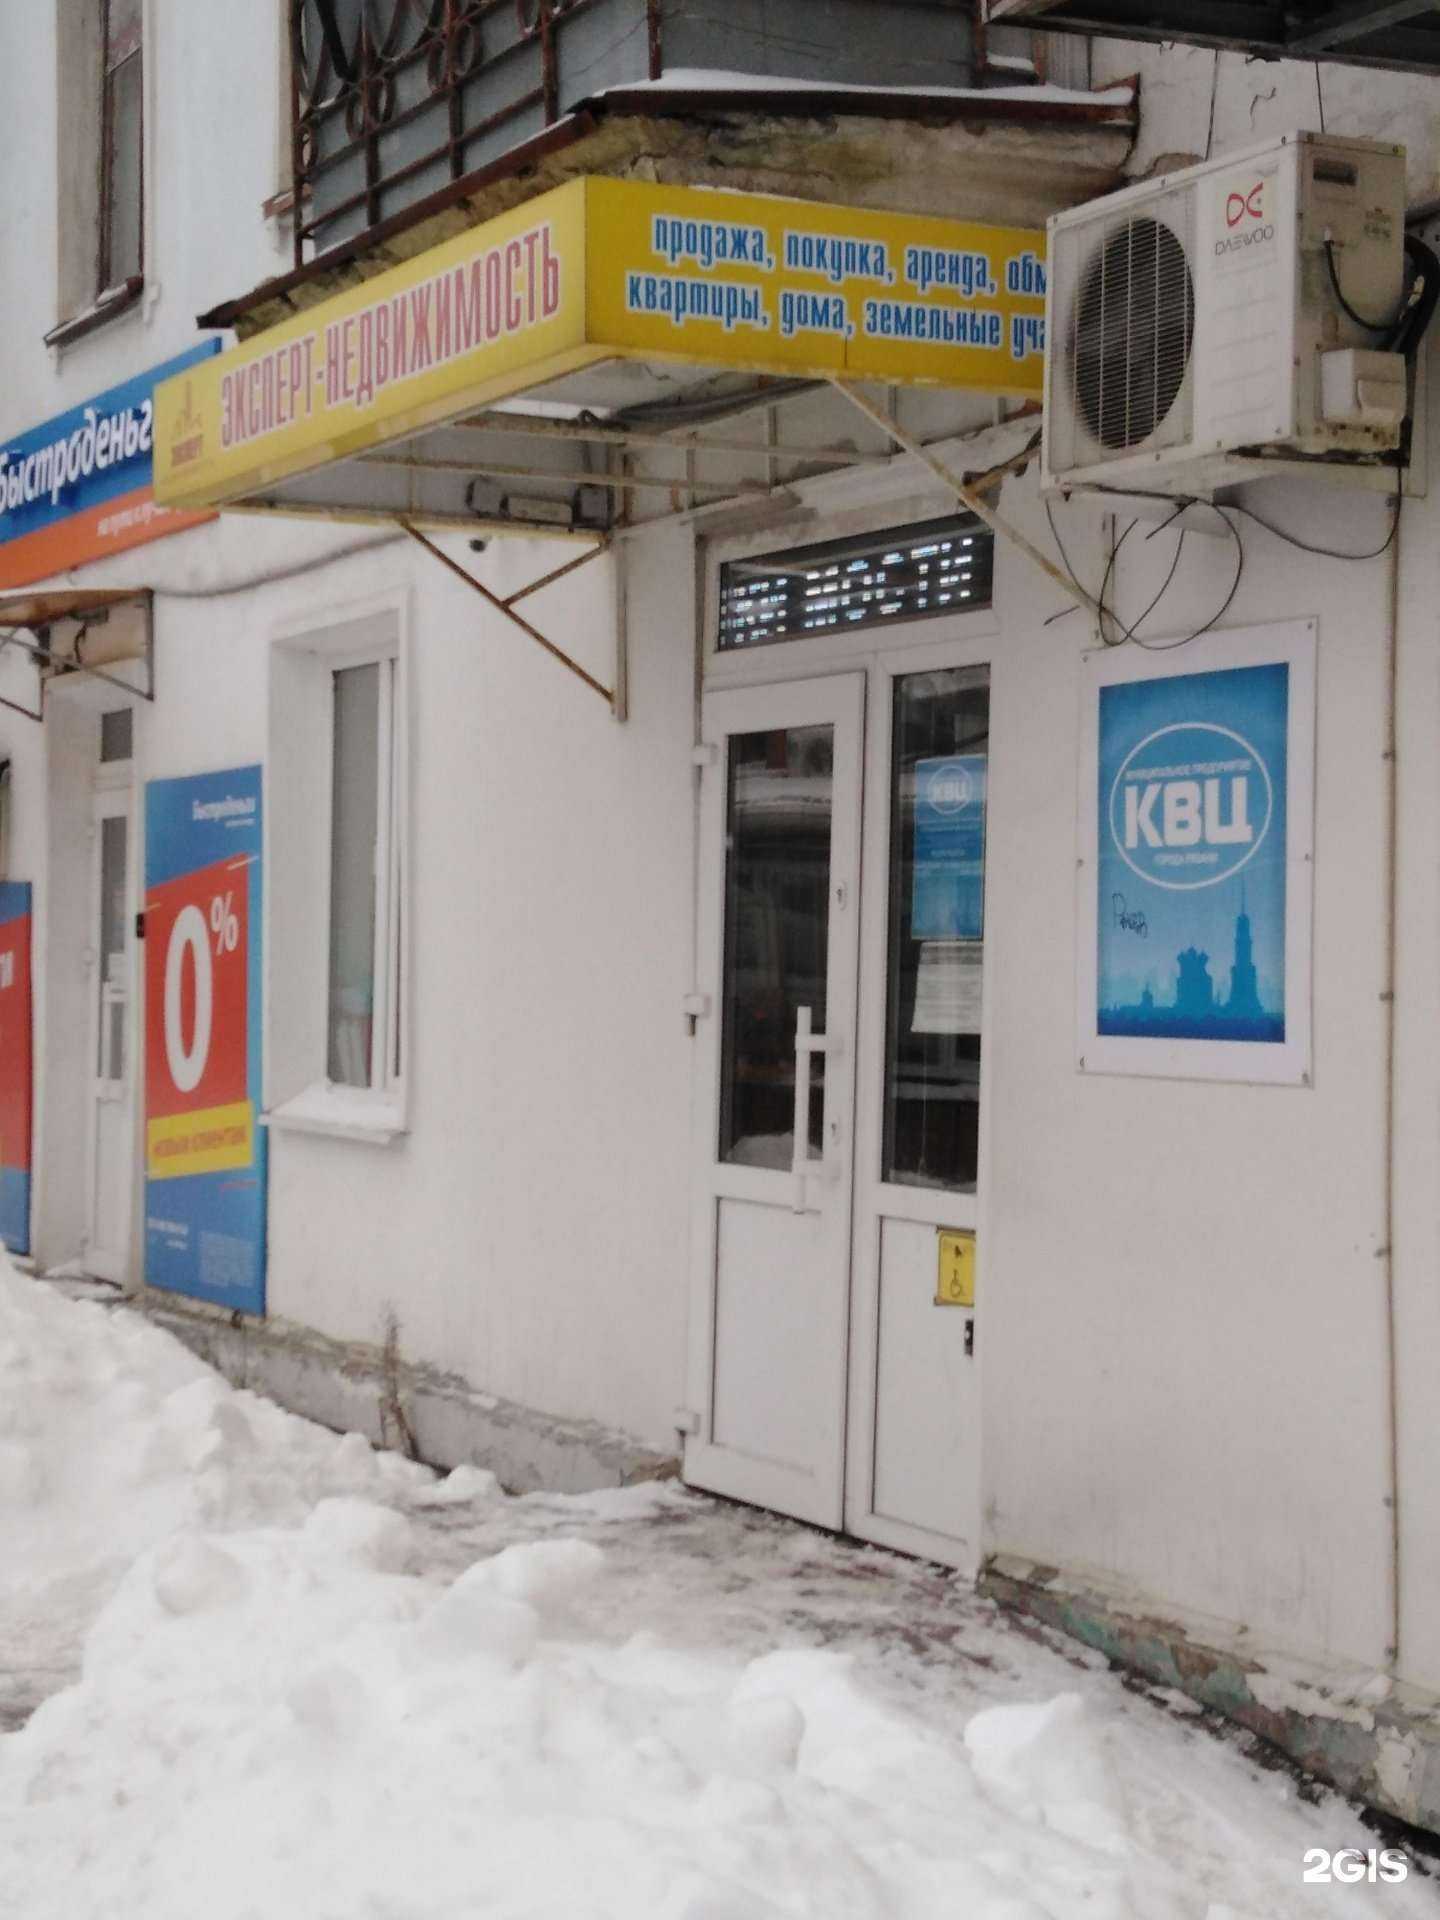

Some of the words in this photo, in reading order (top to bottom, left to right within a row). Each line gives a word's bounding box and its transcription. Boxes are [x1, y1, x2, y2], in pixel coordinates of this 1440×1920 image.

[654, 217, 773, 268] продажа,
[786, 233, 894, 283] покупка,
[906, 248, 996, 294] аренда,
[1214, 225, 1275, 256] DAEWOO
[221, 225, 561, 449] ЭКСПЕРТ-НЕДВИЖИМОСТЬ
[627, 275, 768, 327] квартиры,
[781, 293, 853, 335] дома,
[865, 301, 1001, 347] земельные
[1125, 776, 1253, 849] КВЦ
